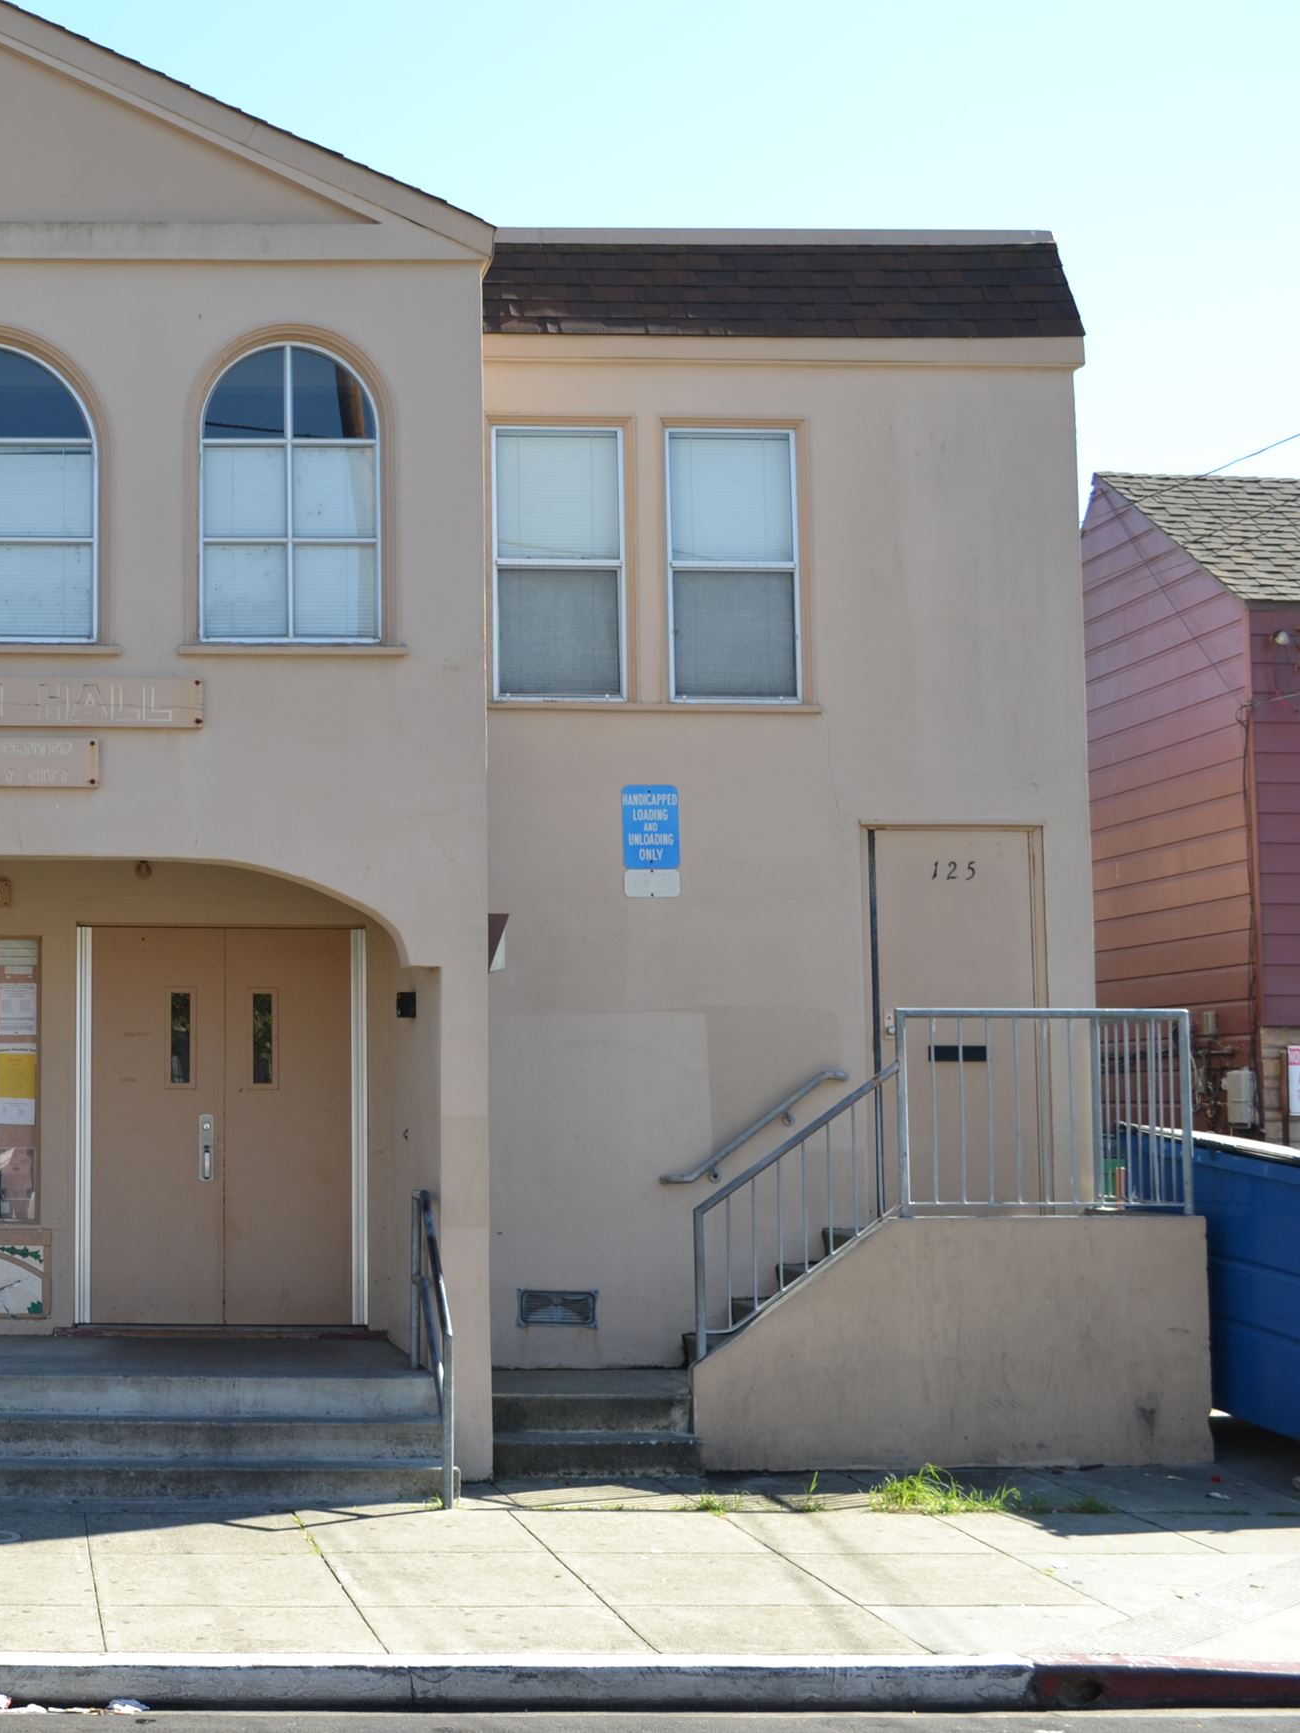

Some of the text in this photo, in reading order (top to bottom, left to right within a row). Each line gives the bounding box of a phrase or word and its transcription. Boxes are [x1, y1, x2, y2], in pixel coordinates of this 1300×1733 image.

[37, 683, 173, 722] HALL
[2, 742, 75, 757] CENTER
[27, 769, 72, 784] CITY
[623, 793, 677, 806] HANDICAPPED
[633, 809, 668, 821] LOADING
[644, 822, 658, 832] AND
[628, 834, 674, 846] UNLOADING
[639, 849, 664, 861] ONLY
[931, 860, 976, 880] 125
